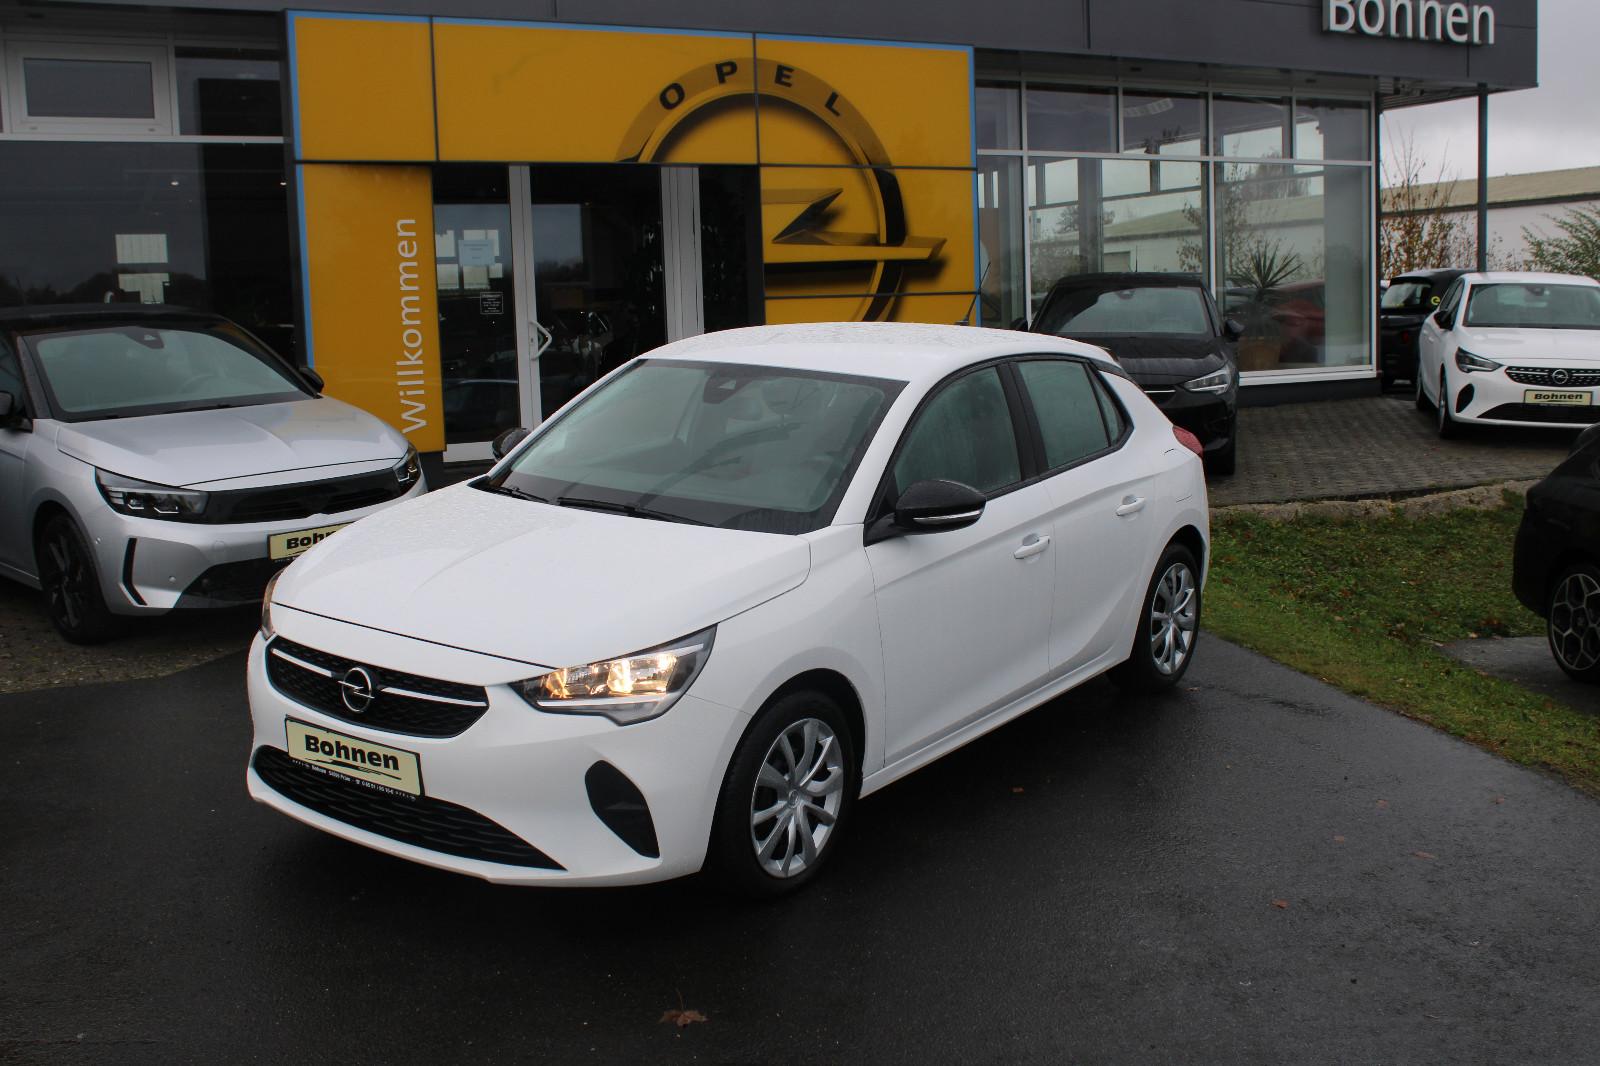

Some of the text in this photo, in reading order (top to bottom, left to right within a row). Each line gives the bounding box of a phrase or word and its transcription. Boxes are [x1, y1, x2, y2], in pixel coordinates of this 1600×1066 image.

[1323, 0, 1495, 45] Bohnen
[659, 60, 842, 118] OPEL
[396, 218, 427, 434] Willkommen
[305, 734, 400, 771] Bohnen
